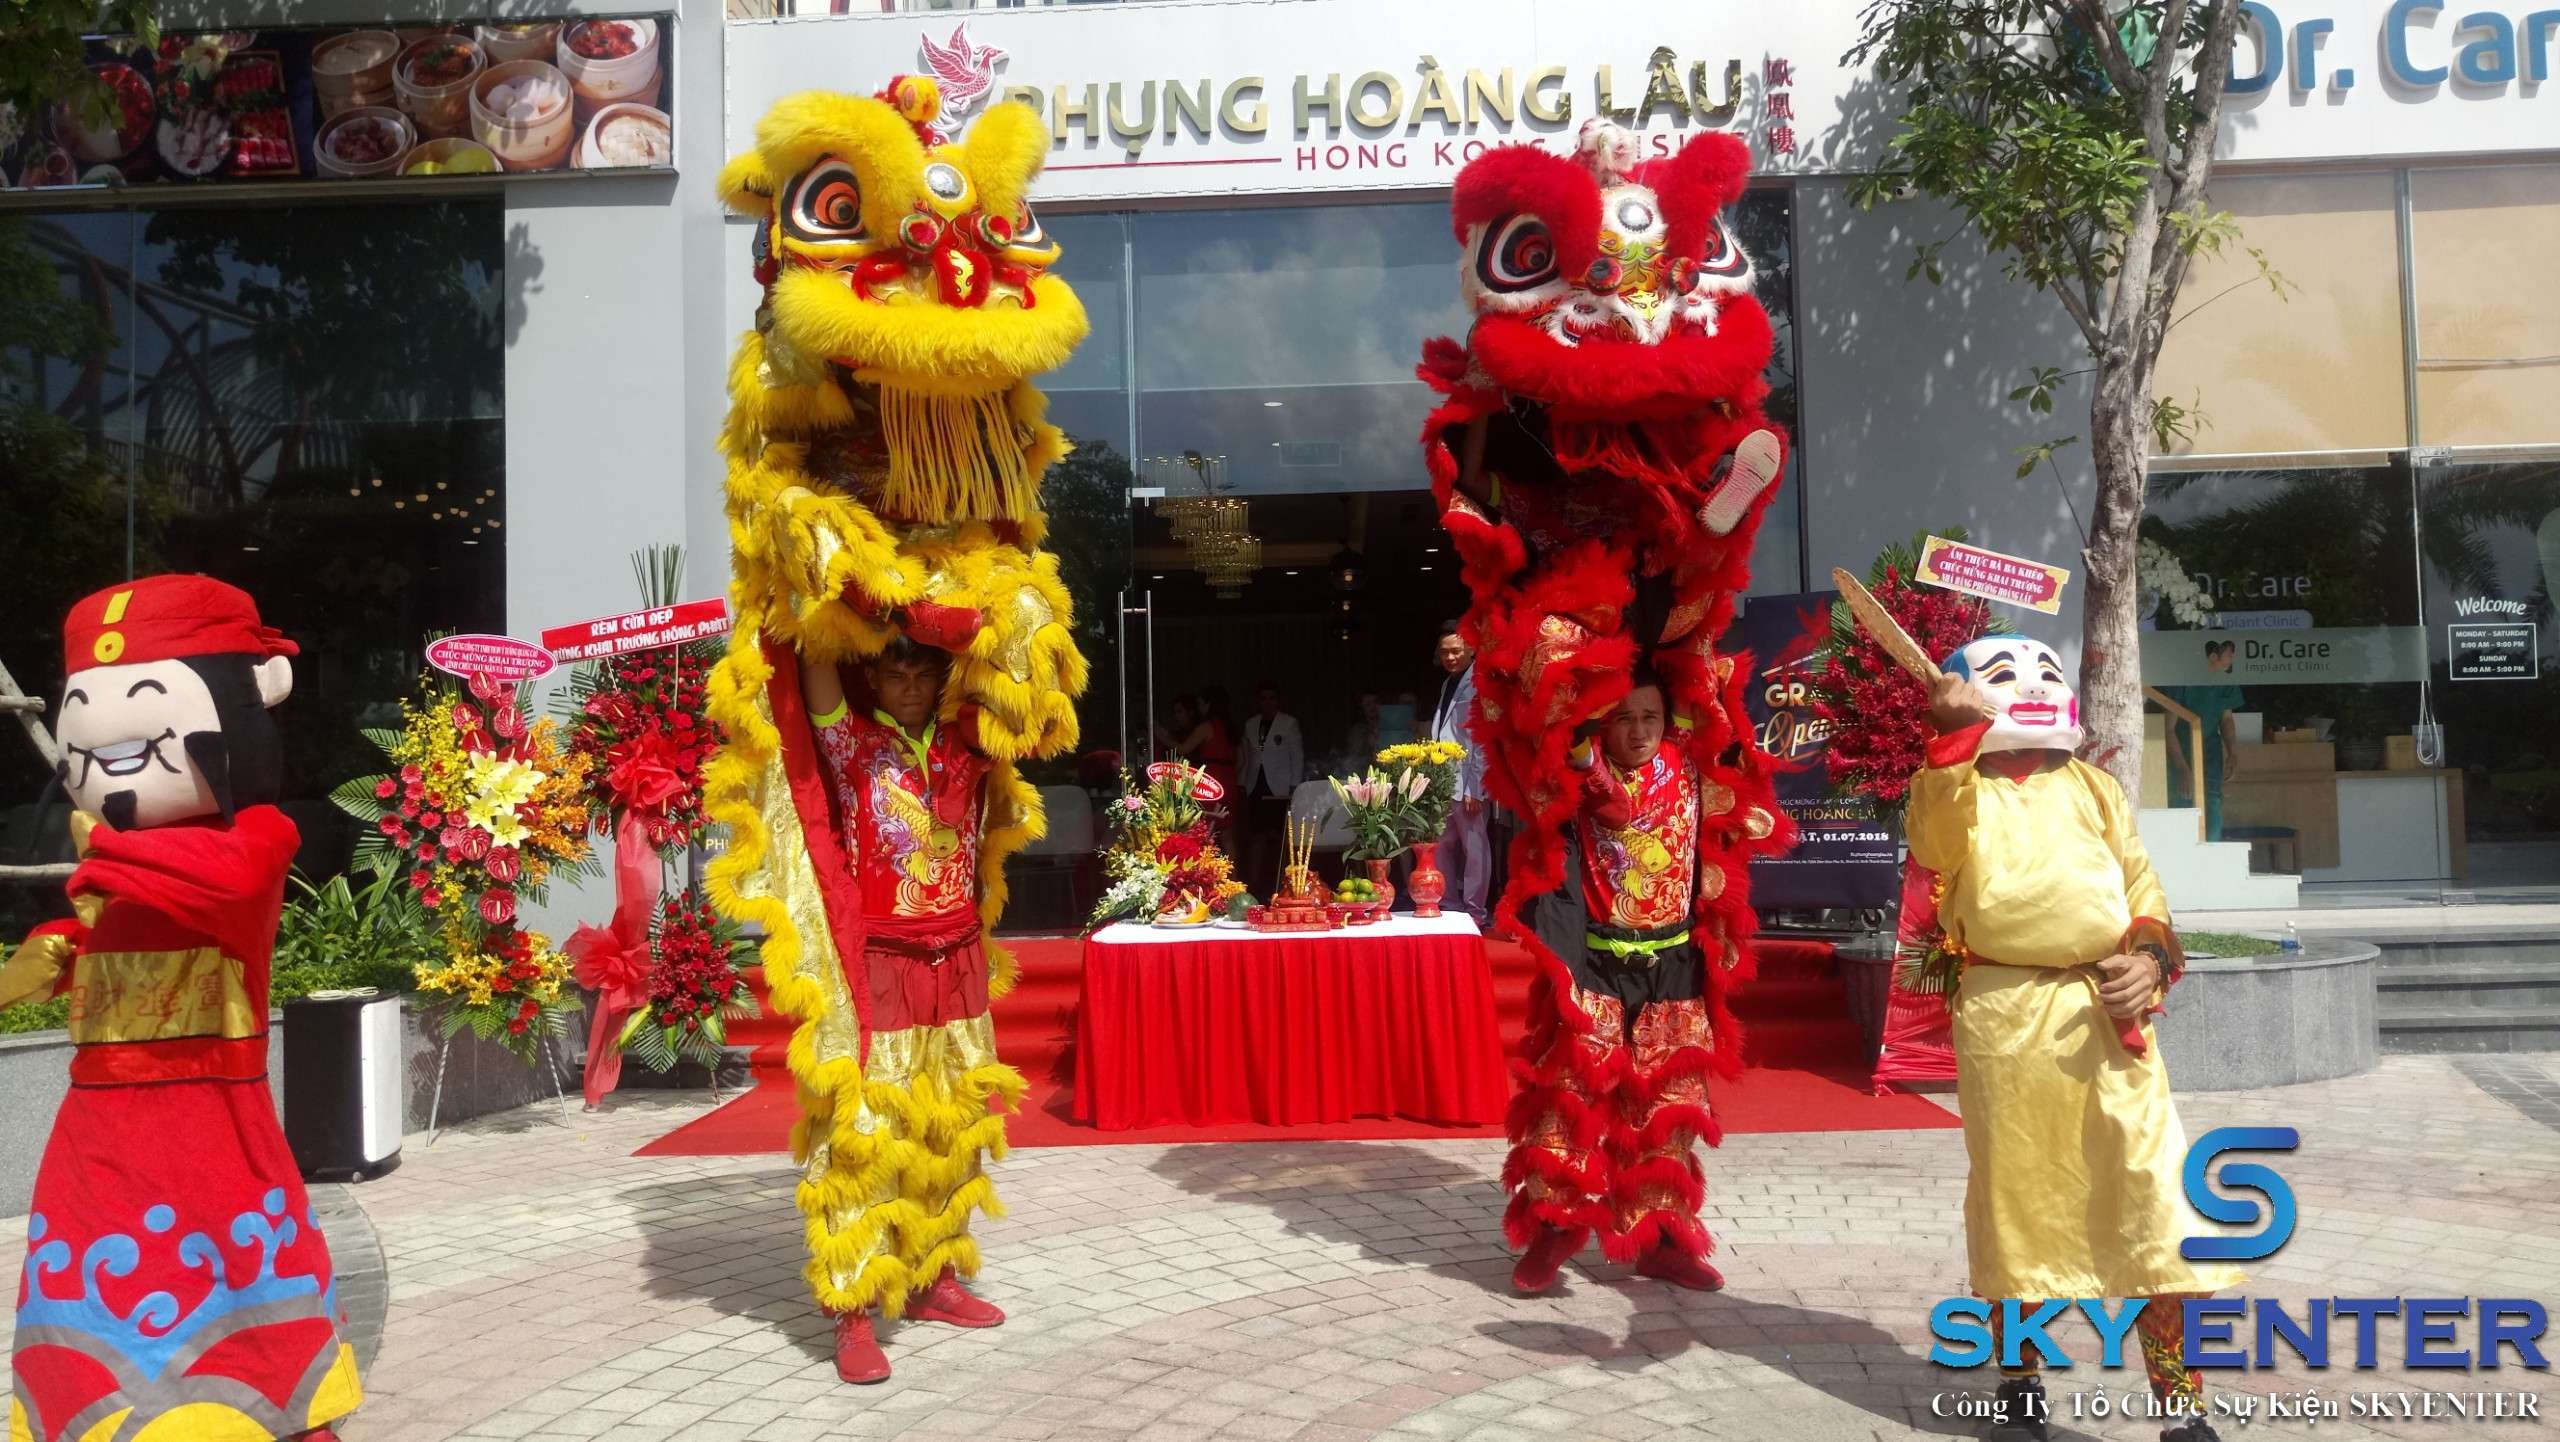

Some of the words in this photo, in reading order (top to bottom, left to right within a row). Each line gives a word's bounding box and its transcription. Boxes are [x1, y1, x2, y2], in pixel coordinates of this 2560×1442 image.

[2223, 0, 2355, 93] Dr.
[1295, 55, 1571, 129] HOÀNG
[1597, 46, 1742, 120] LÂU
[1766, 59, 1794, 155] 鳳凰樓
[1297, 143, 1407, 170] HONG
[1435, 138, 1545, 166] KO
[2455, 596, 2527, 617] Welcome
[2264, 614, 2300, 628] Clinic
[2456, 630, 2487, 638] MONDAY
[2245, 640, 2274, 659] Dr.
[2279, 639, 2331, 659] Care
[489, 655, 510, 665] KHAI
[2245, 662, 2292, 673] Implant
[2297, 662, 2331, 672] Clinic
[1823, 832, 1889, 843] 01.07.2018
